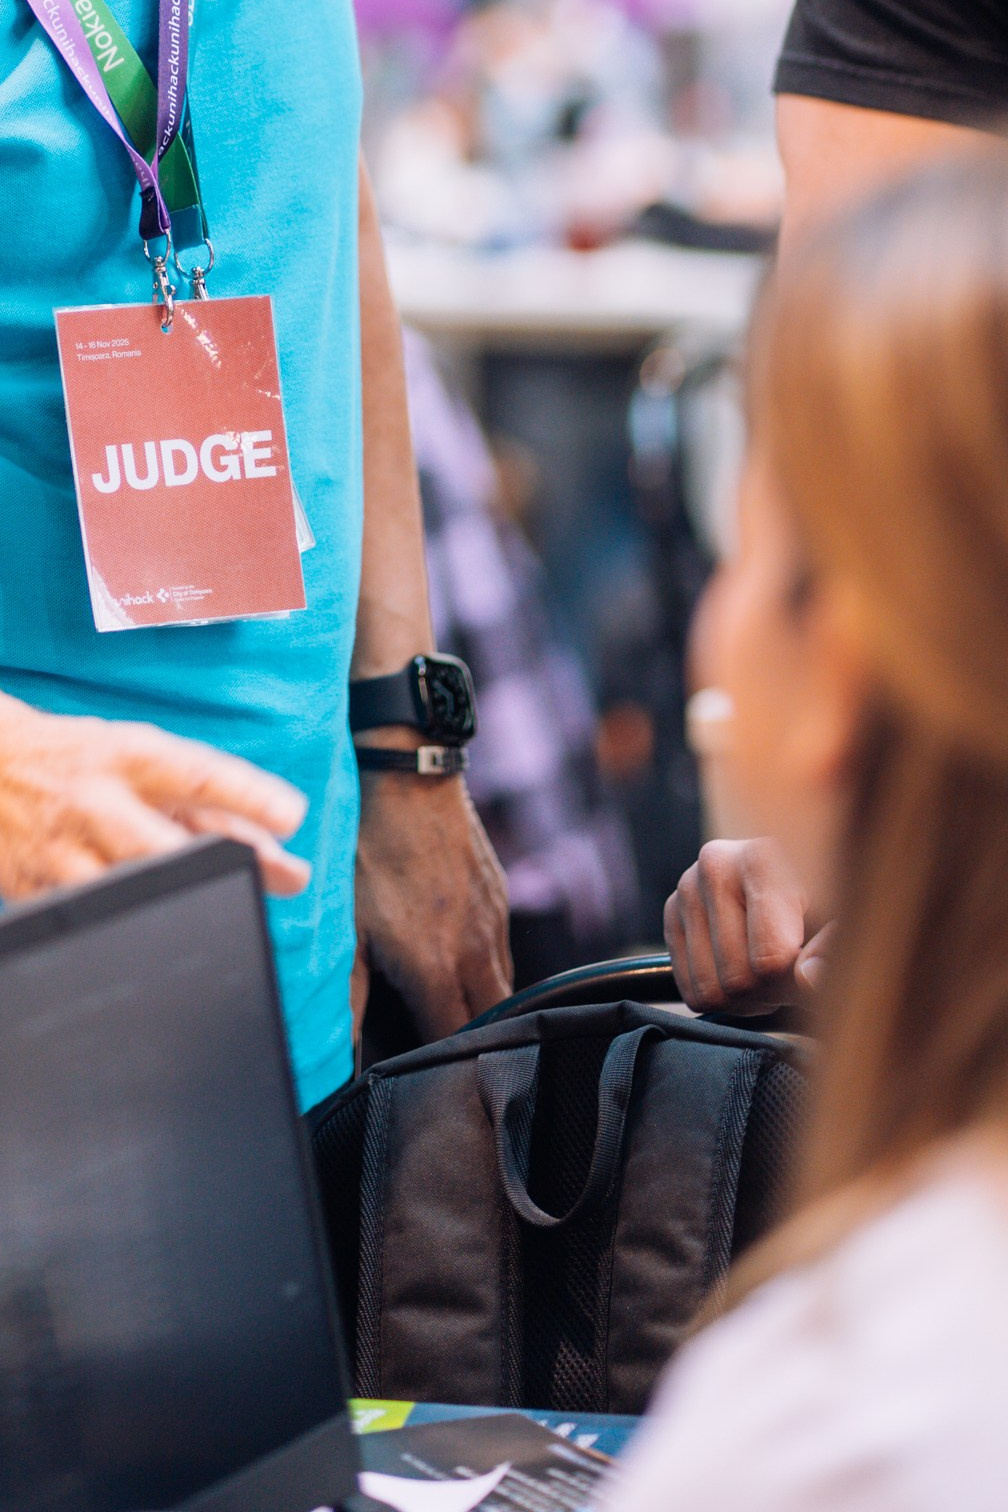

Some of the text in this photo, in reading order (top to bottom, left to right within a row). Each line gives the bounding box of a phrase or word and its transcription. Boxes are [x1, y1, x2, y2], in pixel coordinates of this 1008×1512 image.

[96, 340, 110, 348] Nov
[112, 349, 142, 359] Romania
[92, 430, 277, 494] JUDGE
